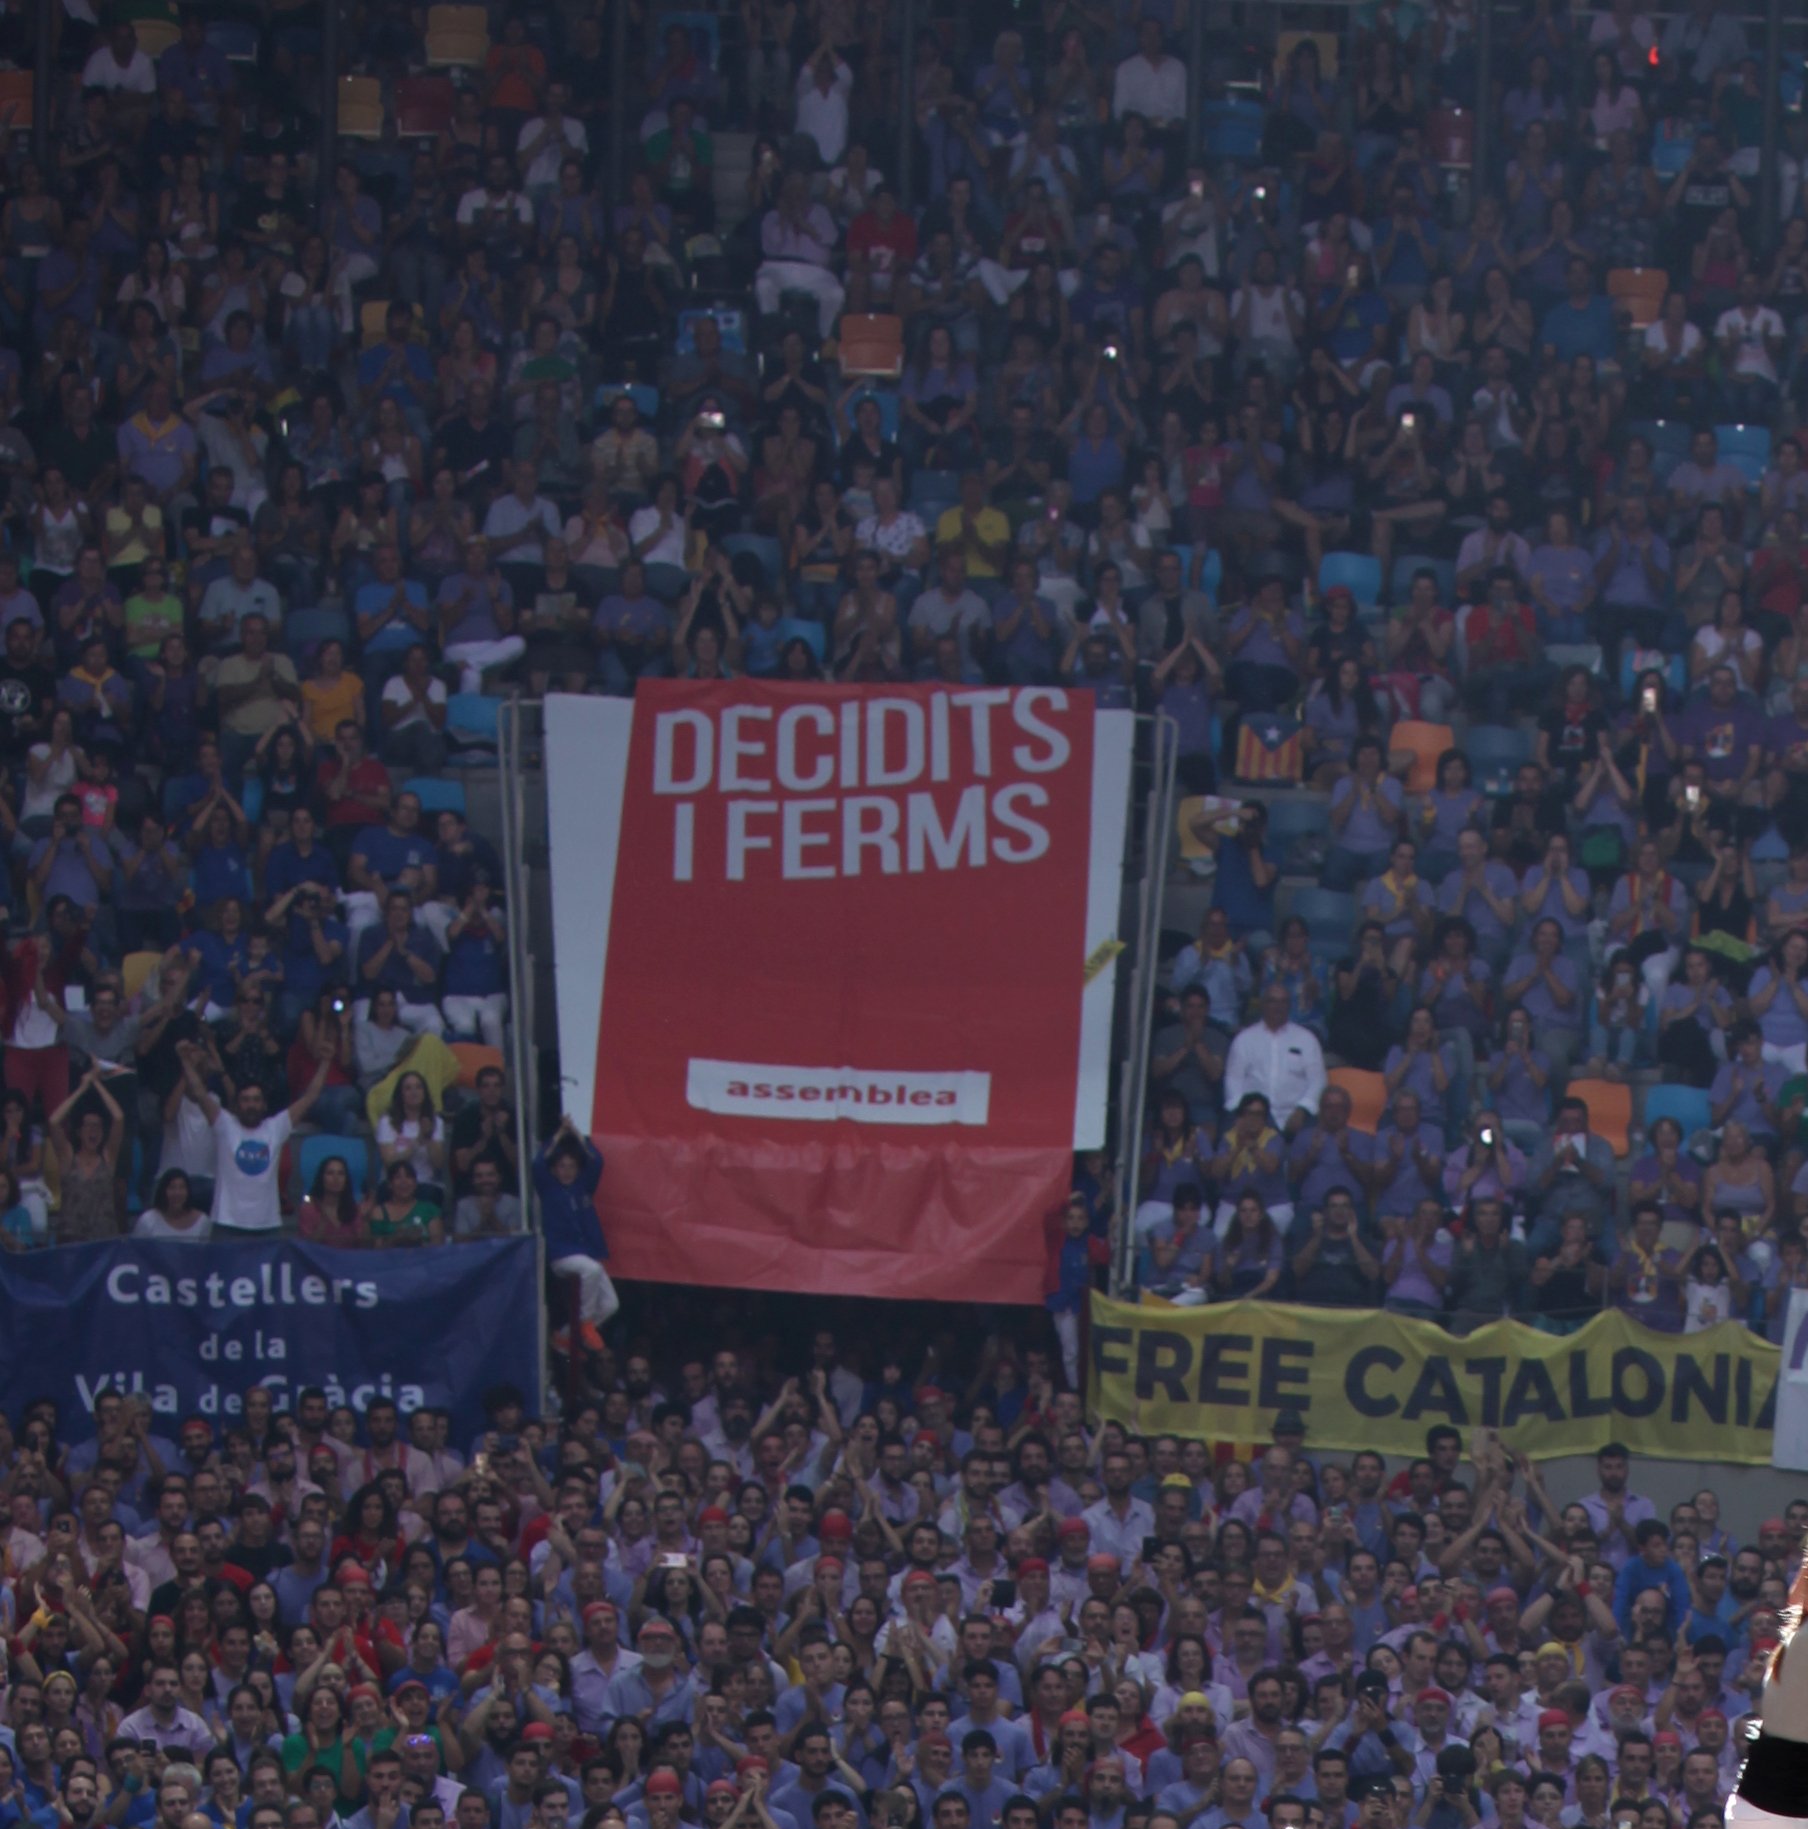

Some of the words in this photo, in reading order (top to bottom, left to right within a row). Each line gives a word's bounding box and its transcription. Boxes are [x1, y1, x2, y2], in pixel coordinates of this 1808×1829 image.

[652, 687, 1071, 795] DECIDITS
[672, 802, 694, 882] I
[725, 783, 1051, 882] FERMS
[725, 1075, 959, 1107] assemblea
[106, 1262, 379, 1309] Castellers
[199, 1332, 243, 1361] de
[255, 1329, 287, 1359] la
[1094, 1324, 1315, 1412] FREE
[198, 1383, 243, 1415] de
